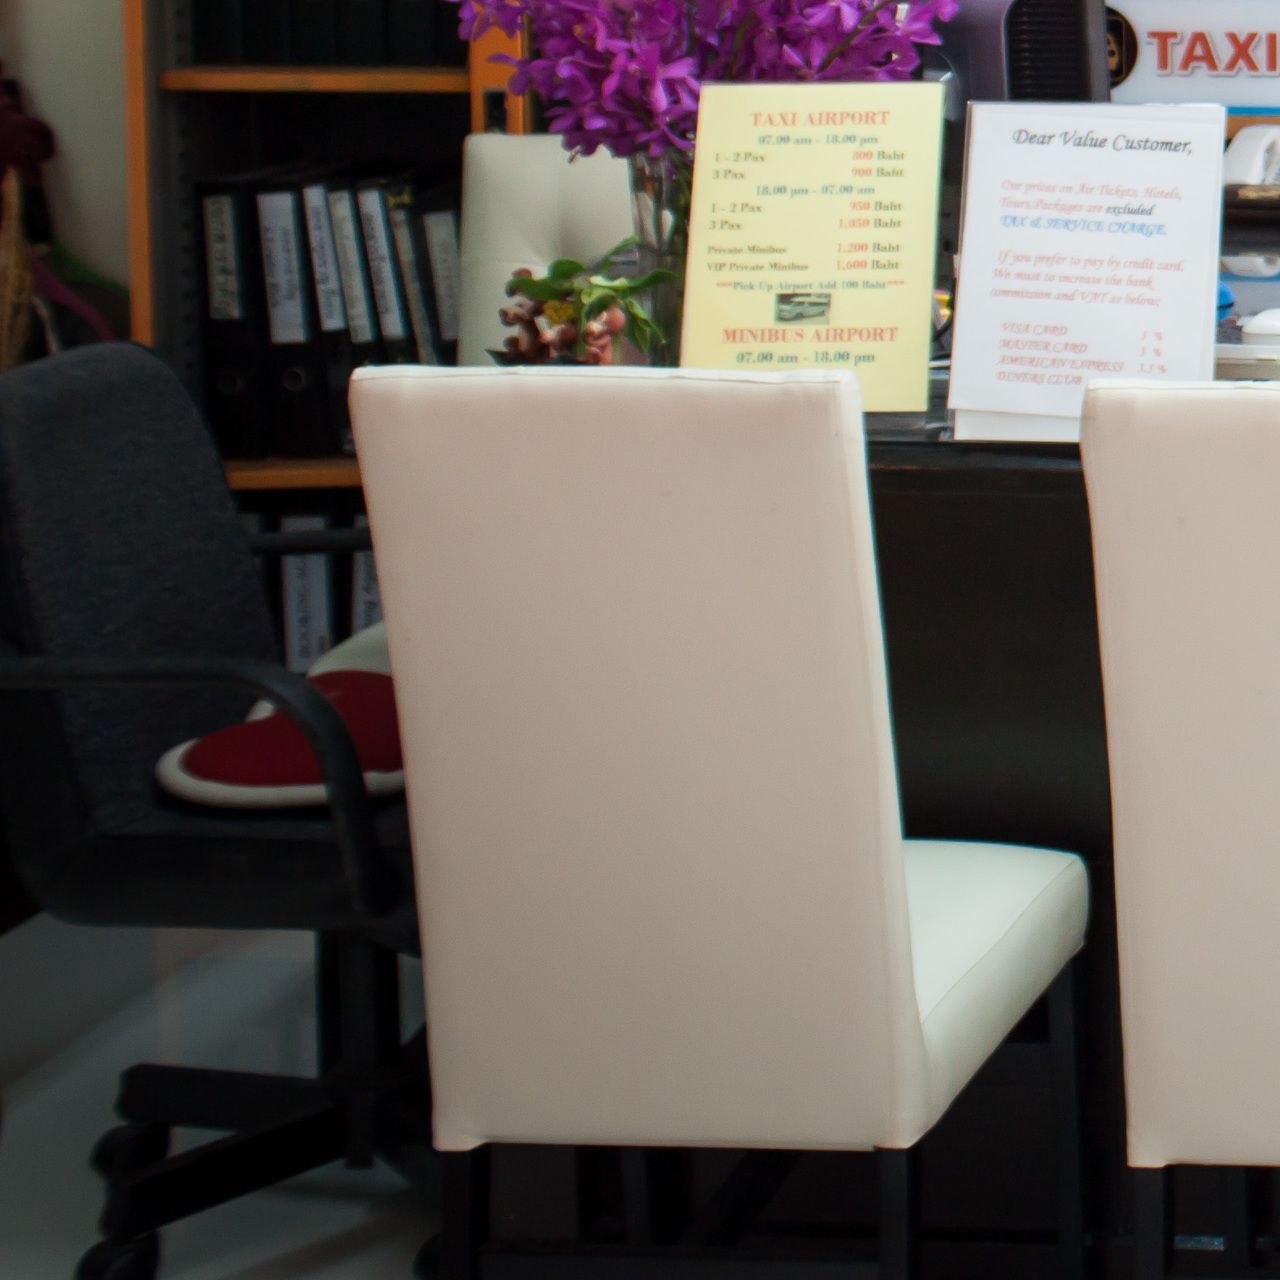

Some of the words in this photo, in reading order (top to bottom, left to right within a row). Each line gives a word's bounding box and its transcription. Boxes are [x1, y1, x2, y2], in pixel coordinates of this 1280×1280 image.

[1147, 30, 1279, 74] TAXI
[751, 111, 800, 127] TAXI
[803, 110, 891, 126] AIRPORT
[792, 136, 813, 146] am
[859, 136, 879, 147] pm
[1012, 128, 1056, 146] Dear
[1060, 130, 1108, 149] Value
[1112, 134, 1193, 156] Customer,
[743, 151, 766, 163] Pax
[876, 150, 905, 161] Baht
[723, 169, 746, 180] Pax
[876, 167, 905, 178] Baht
[789, 187, 809, 198] pm
[856, 186, 876, 195] am
[740, 202, 763, 214] Pax
[874, 200, 903, 212] Baht
[1105, 203, 1154, 216] excluded
[719, 220, 743, 231] Pax
[872, 217, 902, 229] Baht
[999, 214, 1026, 229] TAX
[1044, 217, 1105, 233] SERVICE
[871, 242, 901, 254] Baht
[870, 259, 900, 271] Baht
[721, 327, 805, 345] MINIBUS
[811, 326, 899, 343] AIRPORT
[776, 354, 799, 364] am
[853, 353, 876, 366] pm
